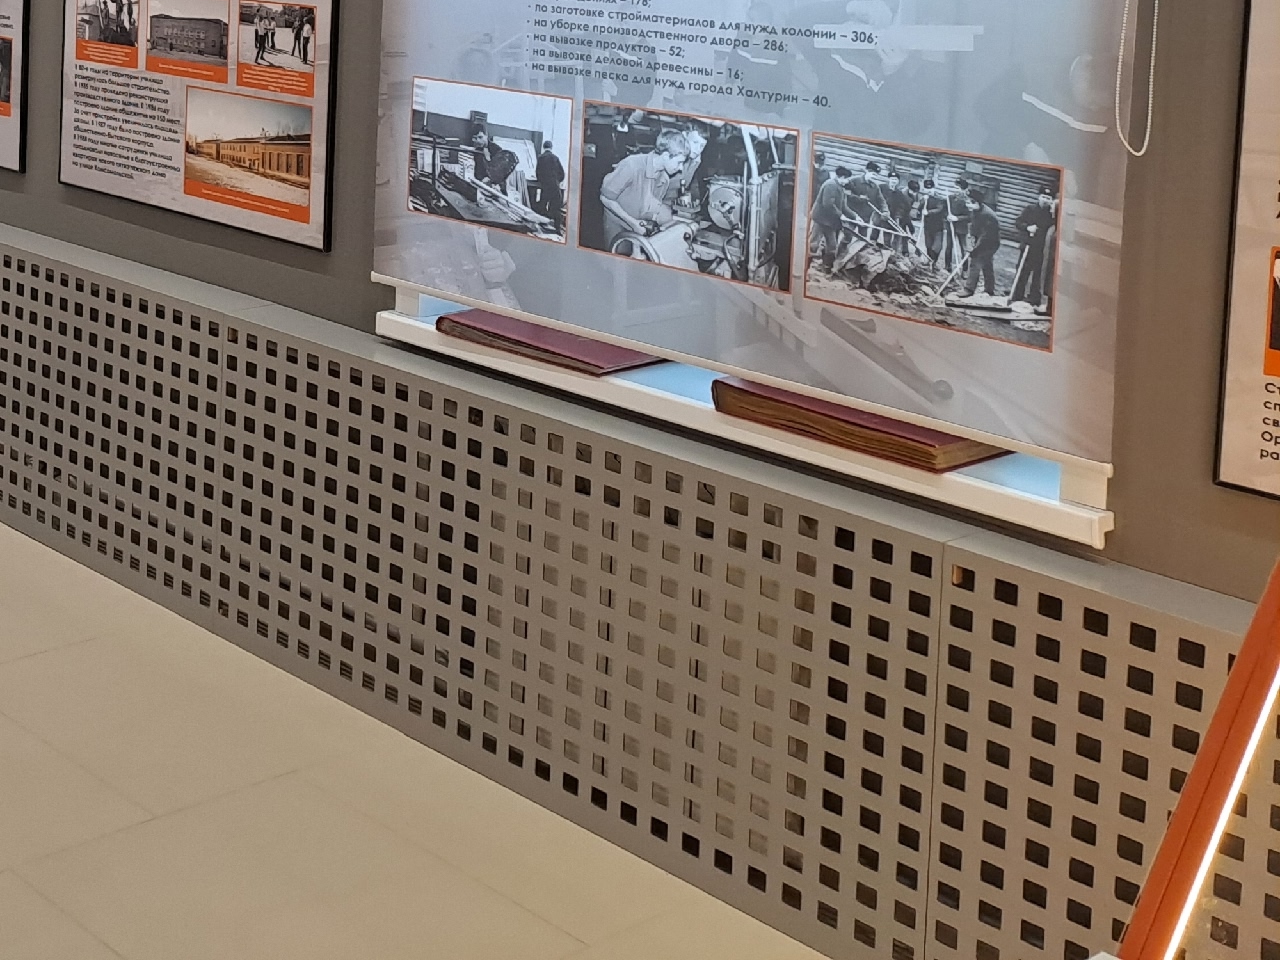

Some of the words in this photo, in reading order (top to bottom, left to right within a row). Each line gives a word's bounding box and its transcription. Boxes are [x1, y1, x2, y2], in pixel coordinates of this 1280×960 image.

[550, 4, 605, 18] заготовке
[606, 10, 716, 29] стройматериалов
[717, 21, 741, 32] для
[743, 22, 778, 36] нужд
[780, 26, 837, 41] колонии
[850, 29, 878, 46] 306;
[546, 63, 592, 77] вывозке
[593, 69, 629, 82] песка
[630, 75, 652, 85] для
[653, 77, 686, 91] нужд
[688, 81, 733, 96] города
[736, 84, 798, 104] Халтурин
[811, 94, 832, 108] 40.
